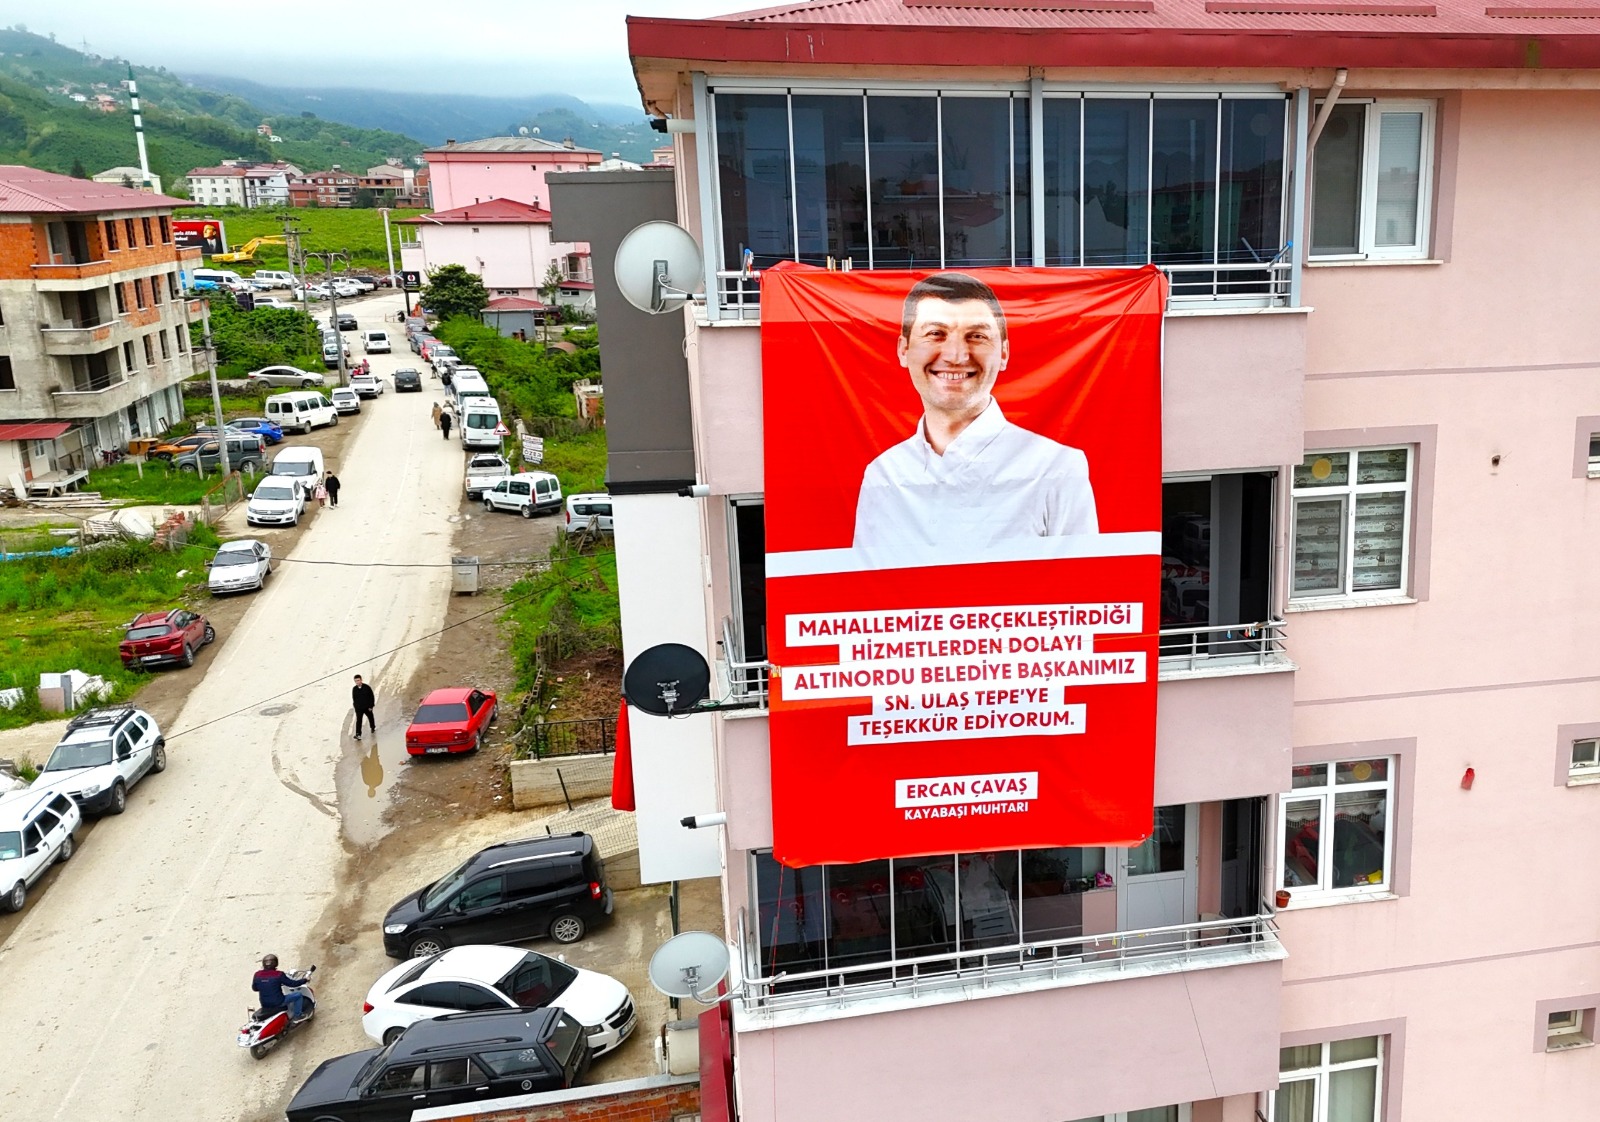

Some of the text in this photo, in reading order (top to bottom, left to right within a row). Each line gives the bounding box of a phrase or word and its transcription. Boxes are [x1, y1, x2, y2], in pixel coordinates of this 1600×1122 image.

[799, 605, 1131, 637] MAHALLEMİZE GERÇEKLEŞTİRDİĞİ
[852, 635, 1082, 661] HİZMETLERDEN DOLAYI
[794, 658, 1135, 690] ALTINORDU BELEDİYE BAŞKANIMIZ
[885, 688, 1049, 711] SN. ULAŞ TEPE'YE
[860, 710, 1075, 738] TEŞEKKÜR EDİYORUM.
[906, 778, 1027, 799] ERCAN ÇAVAŞ
[904, 801, 1028, 820] KAYABAŞI MUHTARI
